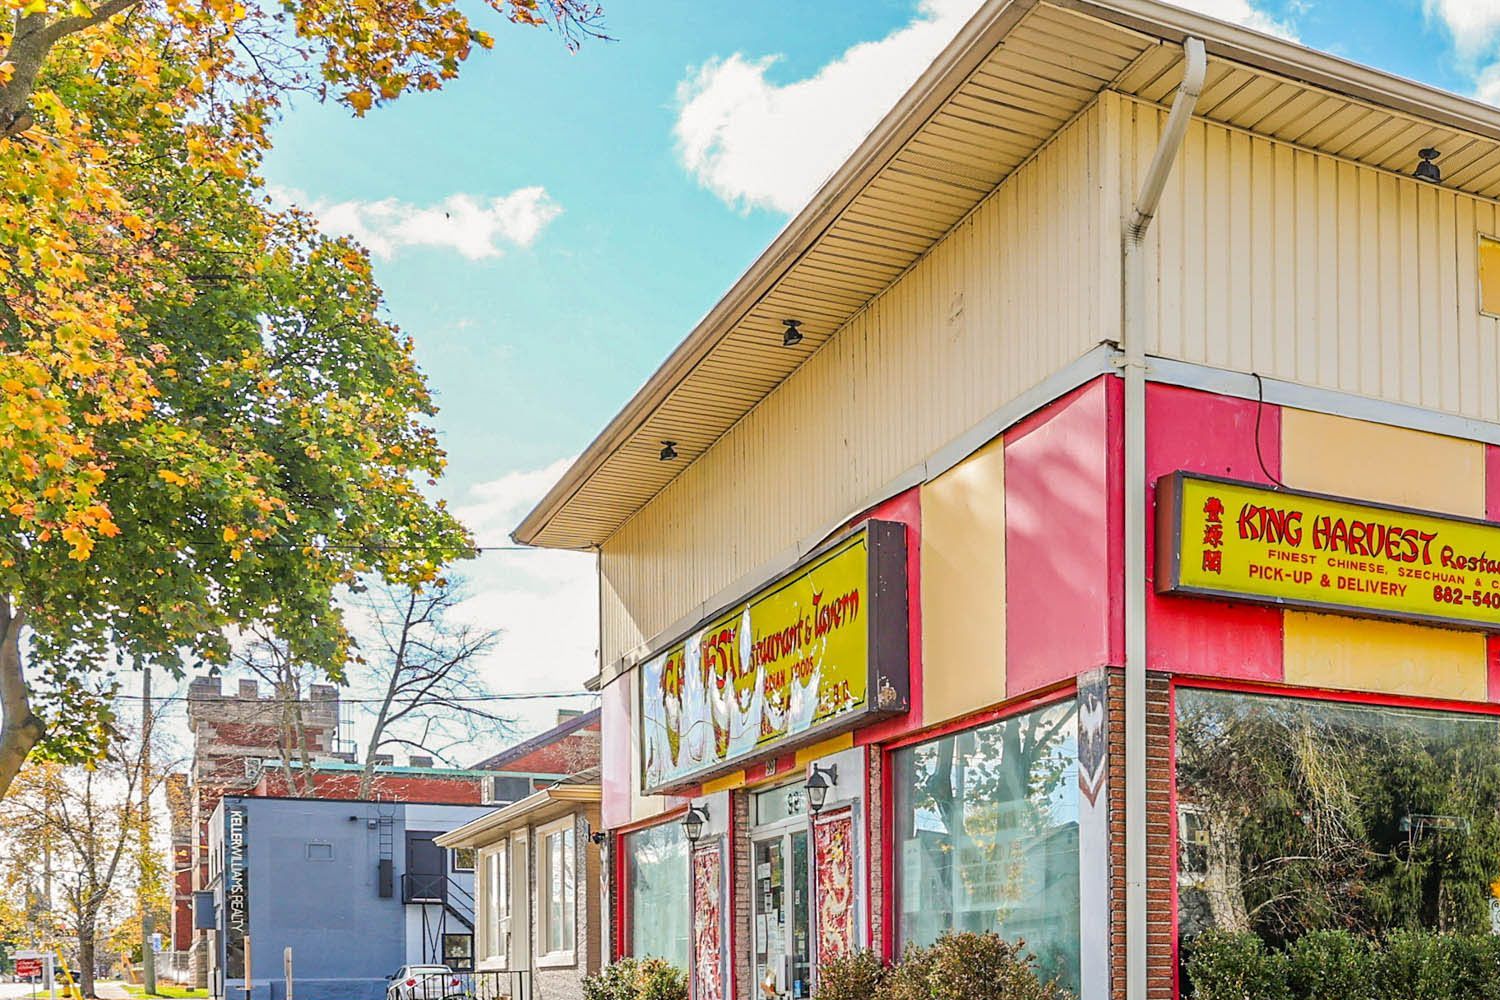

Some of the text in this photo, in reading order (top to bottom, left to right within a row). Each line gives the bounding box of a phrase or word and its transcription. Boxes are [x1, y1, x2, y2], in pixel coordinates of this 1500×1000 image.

[1236, 503, 1303, 548] KING
[1312, 514, 1439, 566] HARVEST
[1249, 564, 1313, 585] PICK-UP
[1320, 573, 1331, 588] &
[1337, 575, 1408, 597] DELIVERY
[1268, 549, 1317, 565] FINEST
[1398, 566, 1466, 585] SZECHUAN
[1474, 577, 1483, 588] &
[812, 587, 860, 640] Tavern
[230, 895, 244, 933] REALTY
